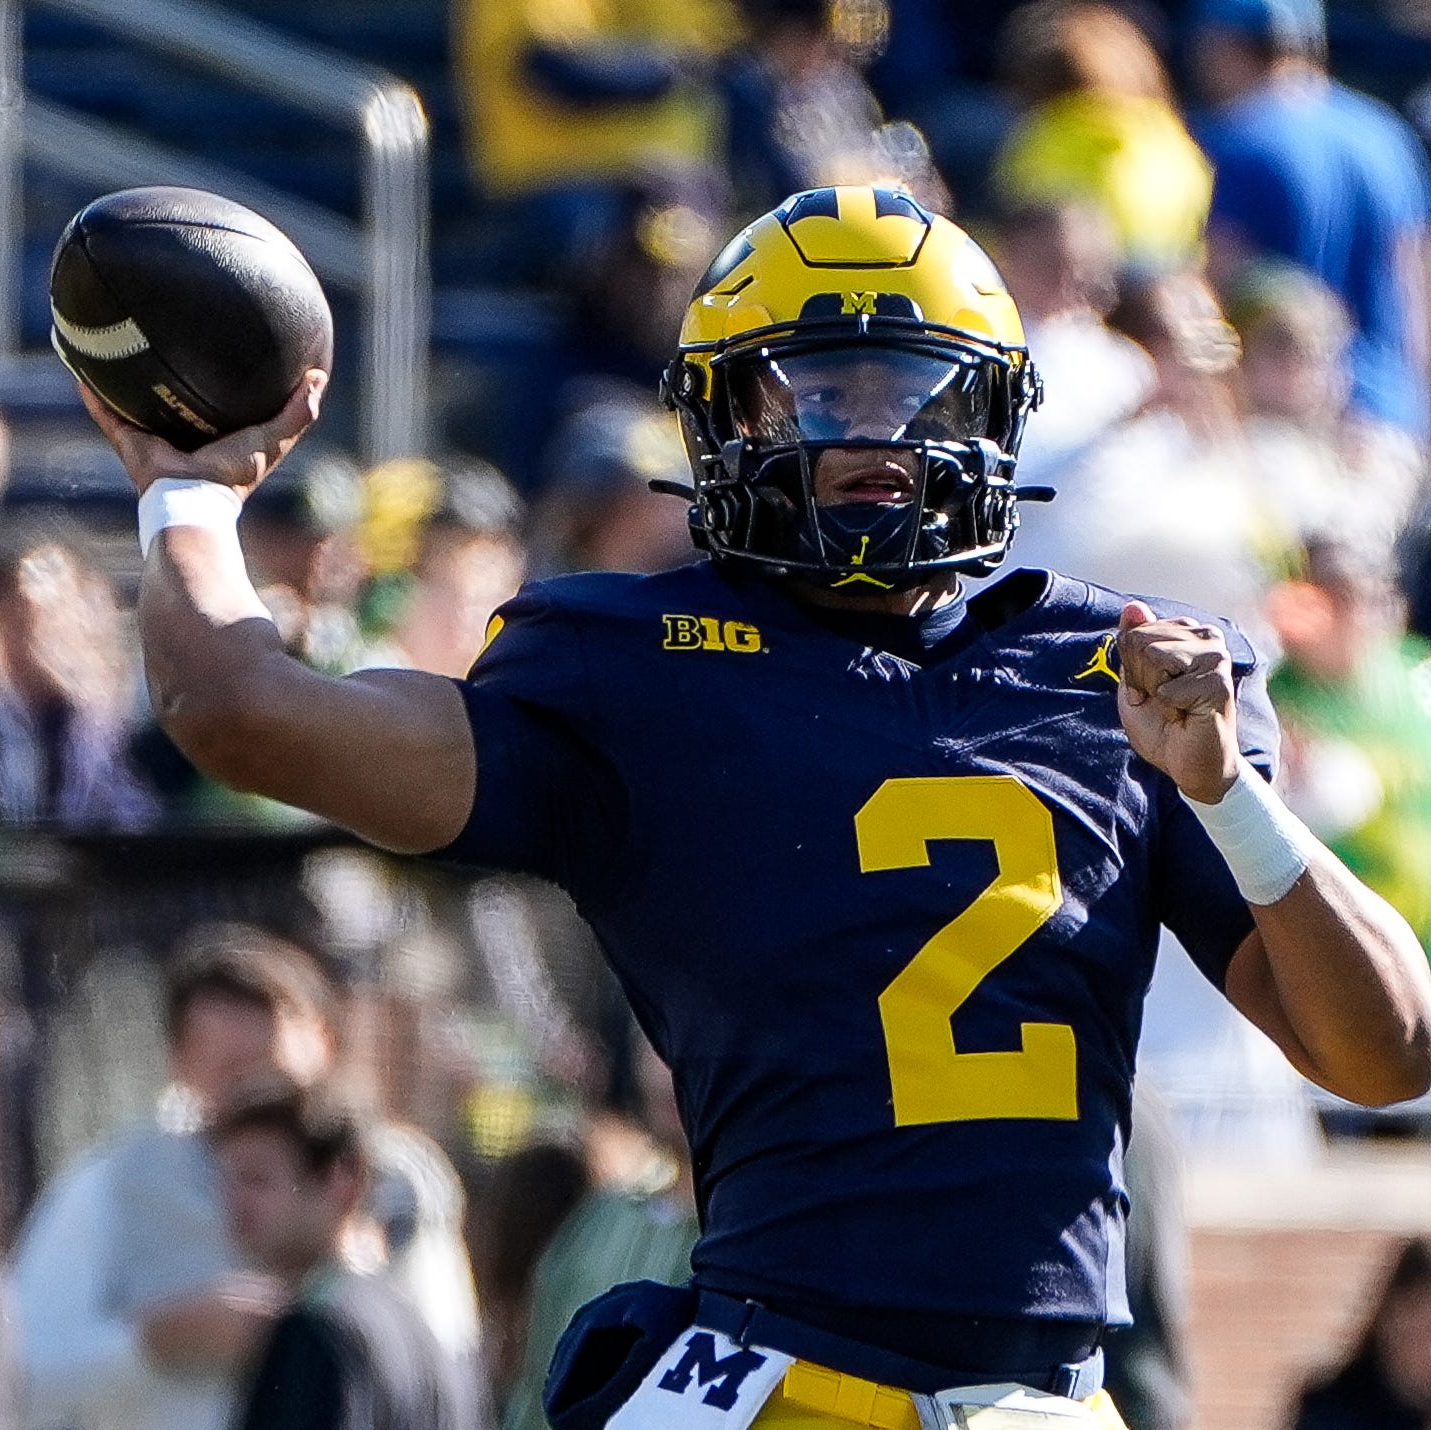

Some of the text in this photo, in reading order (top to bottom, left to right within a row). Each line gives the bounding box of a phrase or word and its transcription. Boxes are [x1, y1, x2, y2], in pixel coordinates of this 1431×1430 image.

[840, 291, 878, 315] M
[854, 775, 1080, 1128] 2
[657, 1332, 768, 1412] M
